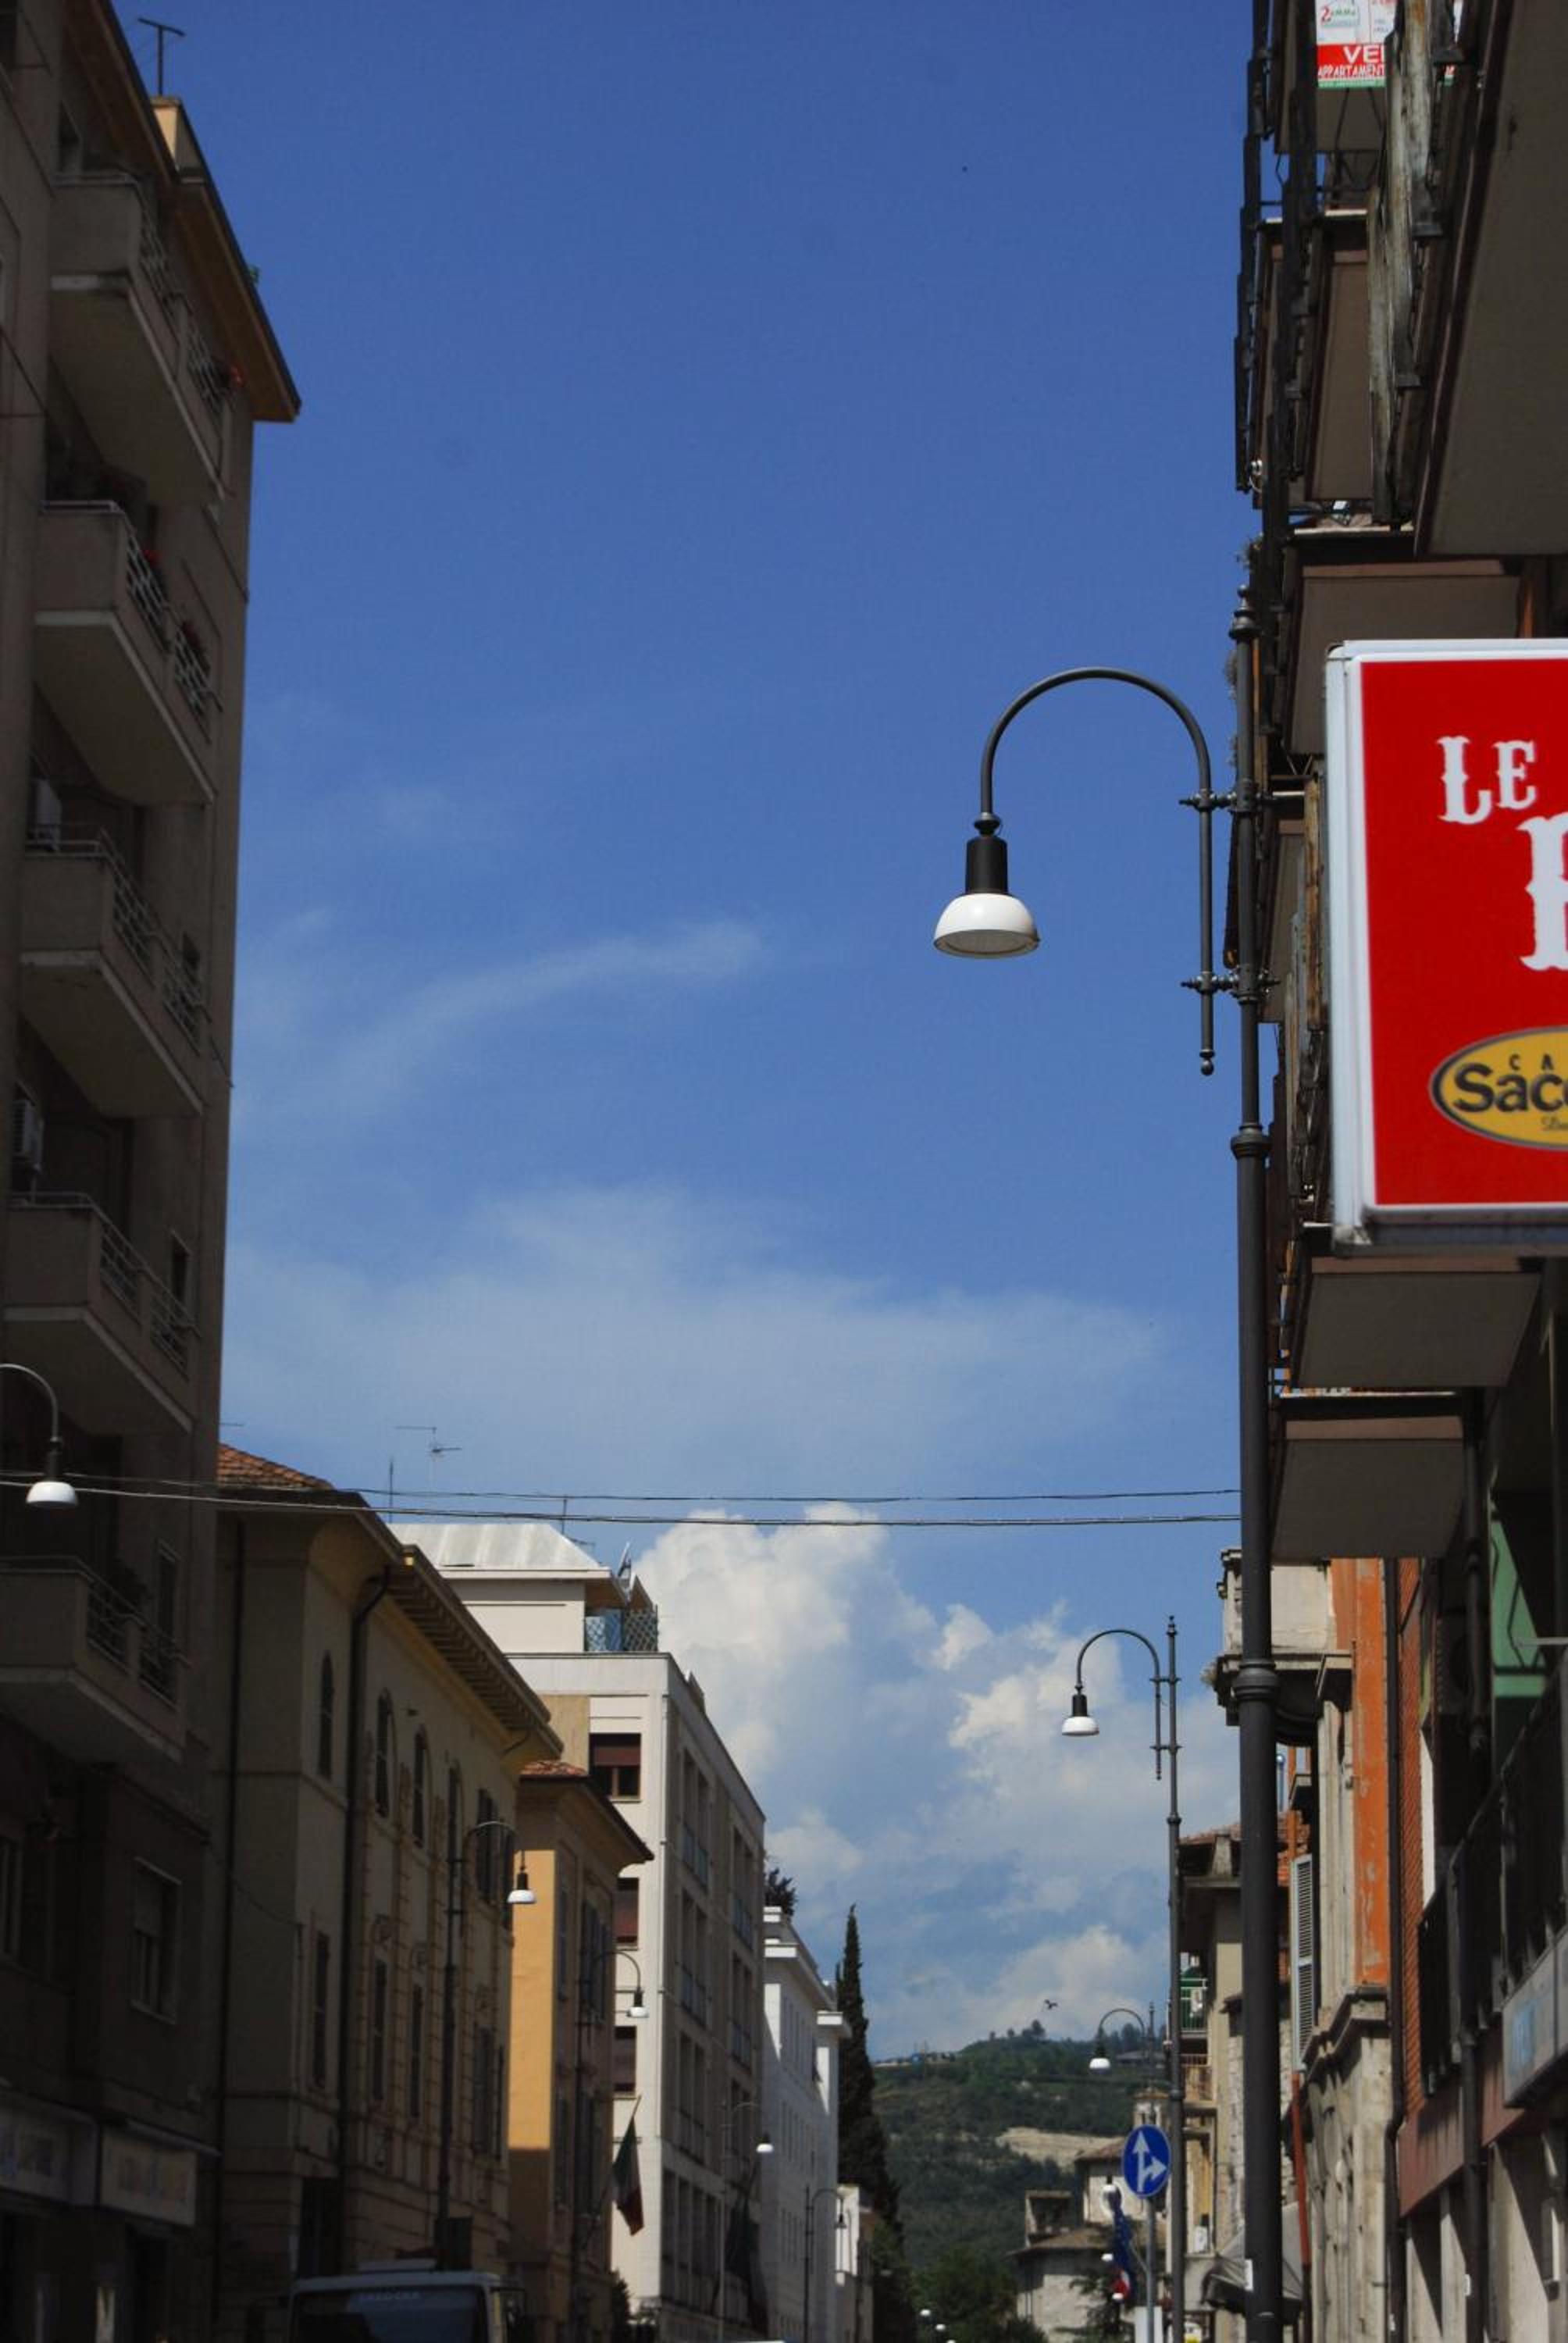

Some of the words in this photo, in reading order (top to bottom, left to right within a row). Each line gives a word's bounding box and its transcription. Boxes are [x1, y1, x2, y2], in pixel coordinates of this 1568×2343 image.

[1342, 45, 1384, 63] VE
[1436, 736, 1537, 824] LE
[1452, 1063, 1568, 1112] Sac
